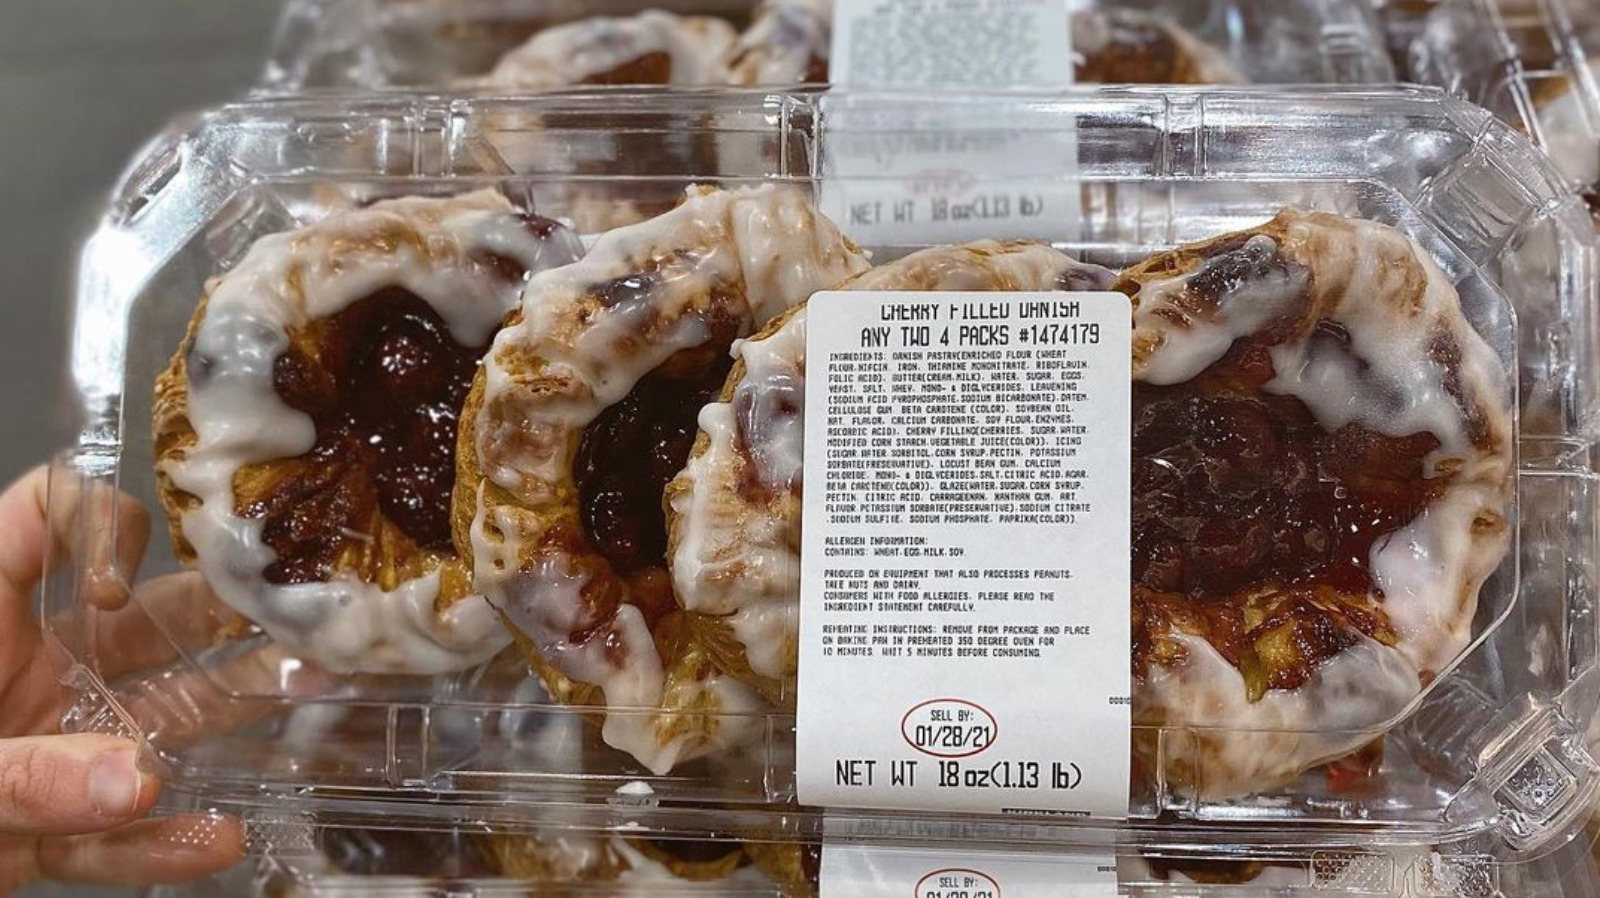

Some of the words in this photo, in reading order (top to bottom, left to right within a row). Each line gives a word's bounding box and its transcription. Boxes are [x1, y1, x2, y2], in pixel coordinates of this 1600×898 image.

[850, 201, 882, 225] NET
[881, 303, 940, 321] CHERRY
[950, 302, 1010, 320] FILLED
[1019, 301, 1080, 319] DANISH
[861, 327, 891, 347] ANY
[901, 326, 930, 347] TWO
[940, 326, 950, 346] 4
[959, 325, 1009, 346] PACKS
[1019, 323, 1100, 345] #1474179
[830, 352, 887, 361] INGREDIENTS:
[892, 351, 923, 360] DANISH
[1006, 350, 1032, 359] FLOUR
[928, 362, 966, 371] THIAMINE
[828, 373, 853, 382] FOLIC
[921, 383, 947, 392] MONO-
[1030, 382, 1076, 391] LEAVENING
[867, 394, 887, 403] ACID
[828, 405, 872, 414] CELLULOSE
[901, 405, 922, 414] BETA
[925, 404, 966, 413] CAROTENE
[1015, 403, 1051, 412] SOYBEAN
[891, 415, 926, 424] CALCIUM
[985, 414, 1001, 423] SOY
[827, 427, 867, 436] ASCORBIC
[906, 426, 936, 435] CHERRY
[827, 437, 867, 446] MODIFIED
[871, 437, 892, 446] CORN
[1056, 437, 1081, 446] ICING
[939, 459, 970, 468] LOCUST
[975, 459, 996, 468] BEAN
[1024, 459, 1061, 468] CALCIUM
[875, 471, 900, 480] MONO-
[826, 481, 847, 490] BETA
[865, 492, 895, 501] CITRIC
[994, 492, 1030, 501] XANTHAN
[1054, 504, 1090, 513] CITRATE
[909, 514, 940, 524] SODIUM
[825, 536, 865, 546] ALLERGEN
[870, 536, 928, 546] INFORMATION:
[825, 548, 868, 557] CONTAINS:
[823, 569, 864, 578] PRODUCED
[868, 569, 879, 578] ON
[883, 569, 928, 578] EQUIPMENT
[934, 569, 953, 578] THAT
[958, 570, 979, 579] ALSO
[983, 570, 1029, 579] PROCESSES
[825, 580, 844, 589] TREE
[848, 580, 869, 589] NUTS
[873, 580, 889, 589] AND
[823, 591, 869, 600] CONSUMERS
[872, 591, 894, 600] WITH
[897, 591, 919, 600] FOOD
[978, 592, 1009, 601] PLEASE
[1013, 592, 1035, 601] READ
[1040, 592, 1054, 601] THE
[823, 603, 873, 612] INGREDIENT
[877, 603, 923, 612] STATEMENT
[823, 624, 868, 633] REHEATING
[873, 624, 936, 633] INSTRUCTIONS:
[942, 625, 973, 634] REMOVE
[978, 625, 999, 634] FROM
[1003, 625, 1039, 634] PACKAGE
[1044, 625, 1059, 634] AND
[1064, 625, 1091, 634] PLACE
[822, 635, 833, 644] ON
[837, 636, 868, 645] BAKING
[872, 636, 888, 645] PAN
[892, 636, 903, 645] IN
[906, 636, 953, 645] PREHEATED
[957, 637, 974, 646] 350
[977, 637, 1009, 646] DEGREE
[1012, 637, 1034, 646] OVEN
[1038, 637, 1054, 646] FOR
[823, 647, 833, 656] 10
[882, 647, 902, 656] WAIT
[906, 647, 913, 656] 5
[916, 648, 953, 657] MINUTES
[957, 648, 988, 657] BEFORE
[930, 710, 953, 722] SELL
[958, 710, 974, 721] BY:
[915, 726, 991, 747] 01/28/21
[835, 760, 876, 787] NET
[891, 760, 918, 787] WT
[938, 761, 959, 788] 18
[1052, 762, 1082, 789] lb)
[939, 876, 959, 888] SELL
[964, 876, 979, 888] BY:
